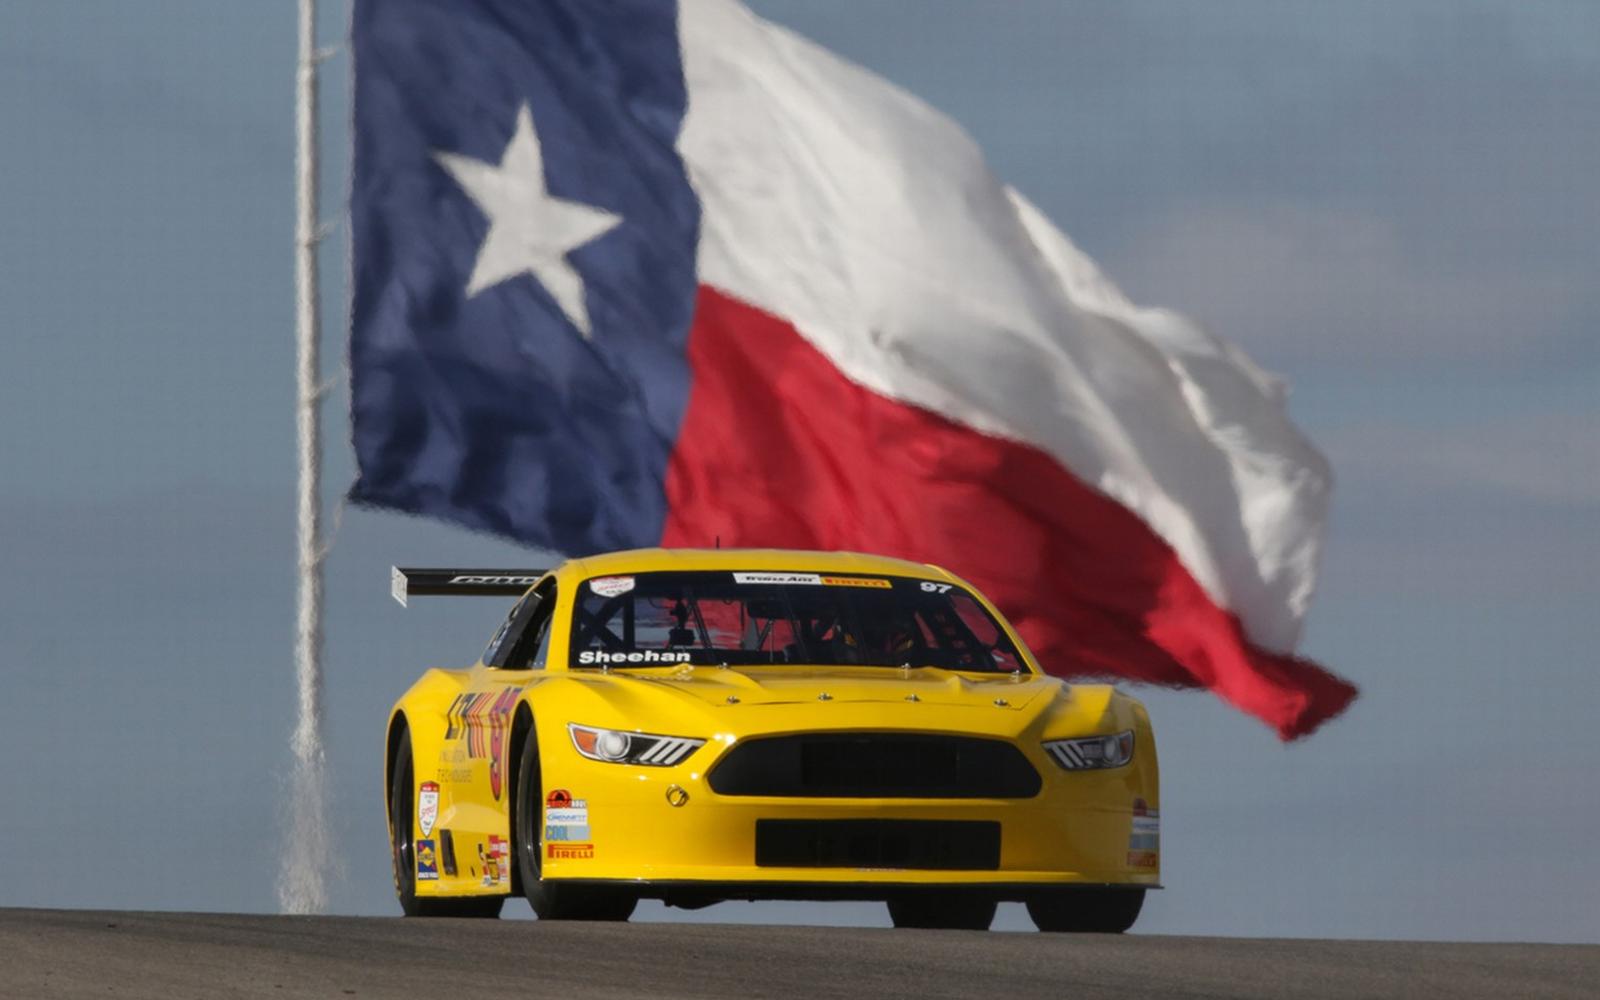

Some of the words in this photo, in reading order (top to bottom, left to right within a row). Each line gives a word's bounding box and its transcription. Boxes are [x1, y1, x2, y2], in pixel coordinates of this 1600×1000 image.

[920, 582, 953, 594] 97
[578, 650, 692, 664] Sheehan
[547, 844, 595, 859] PIRELLI
